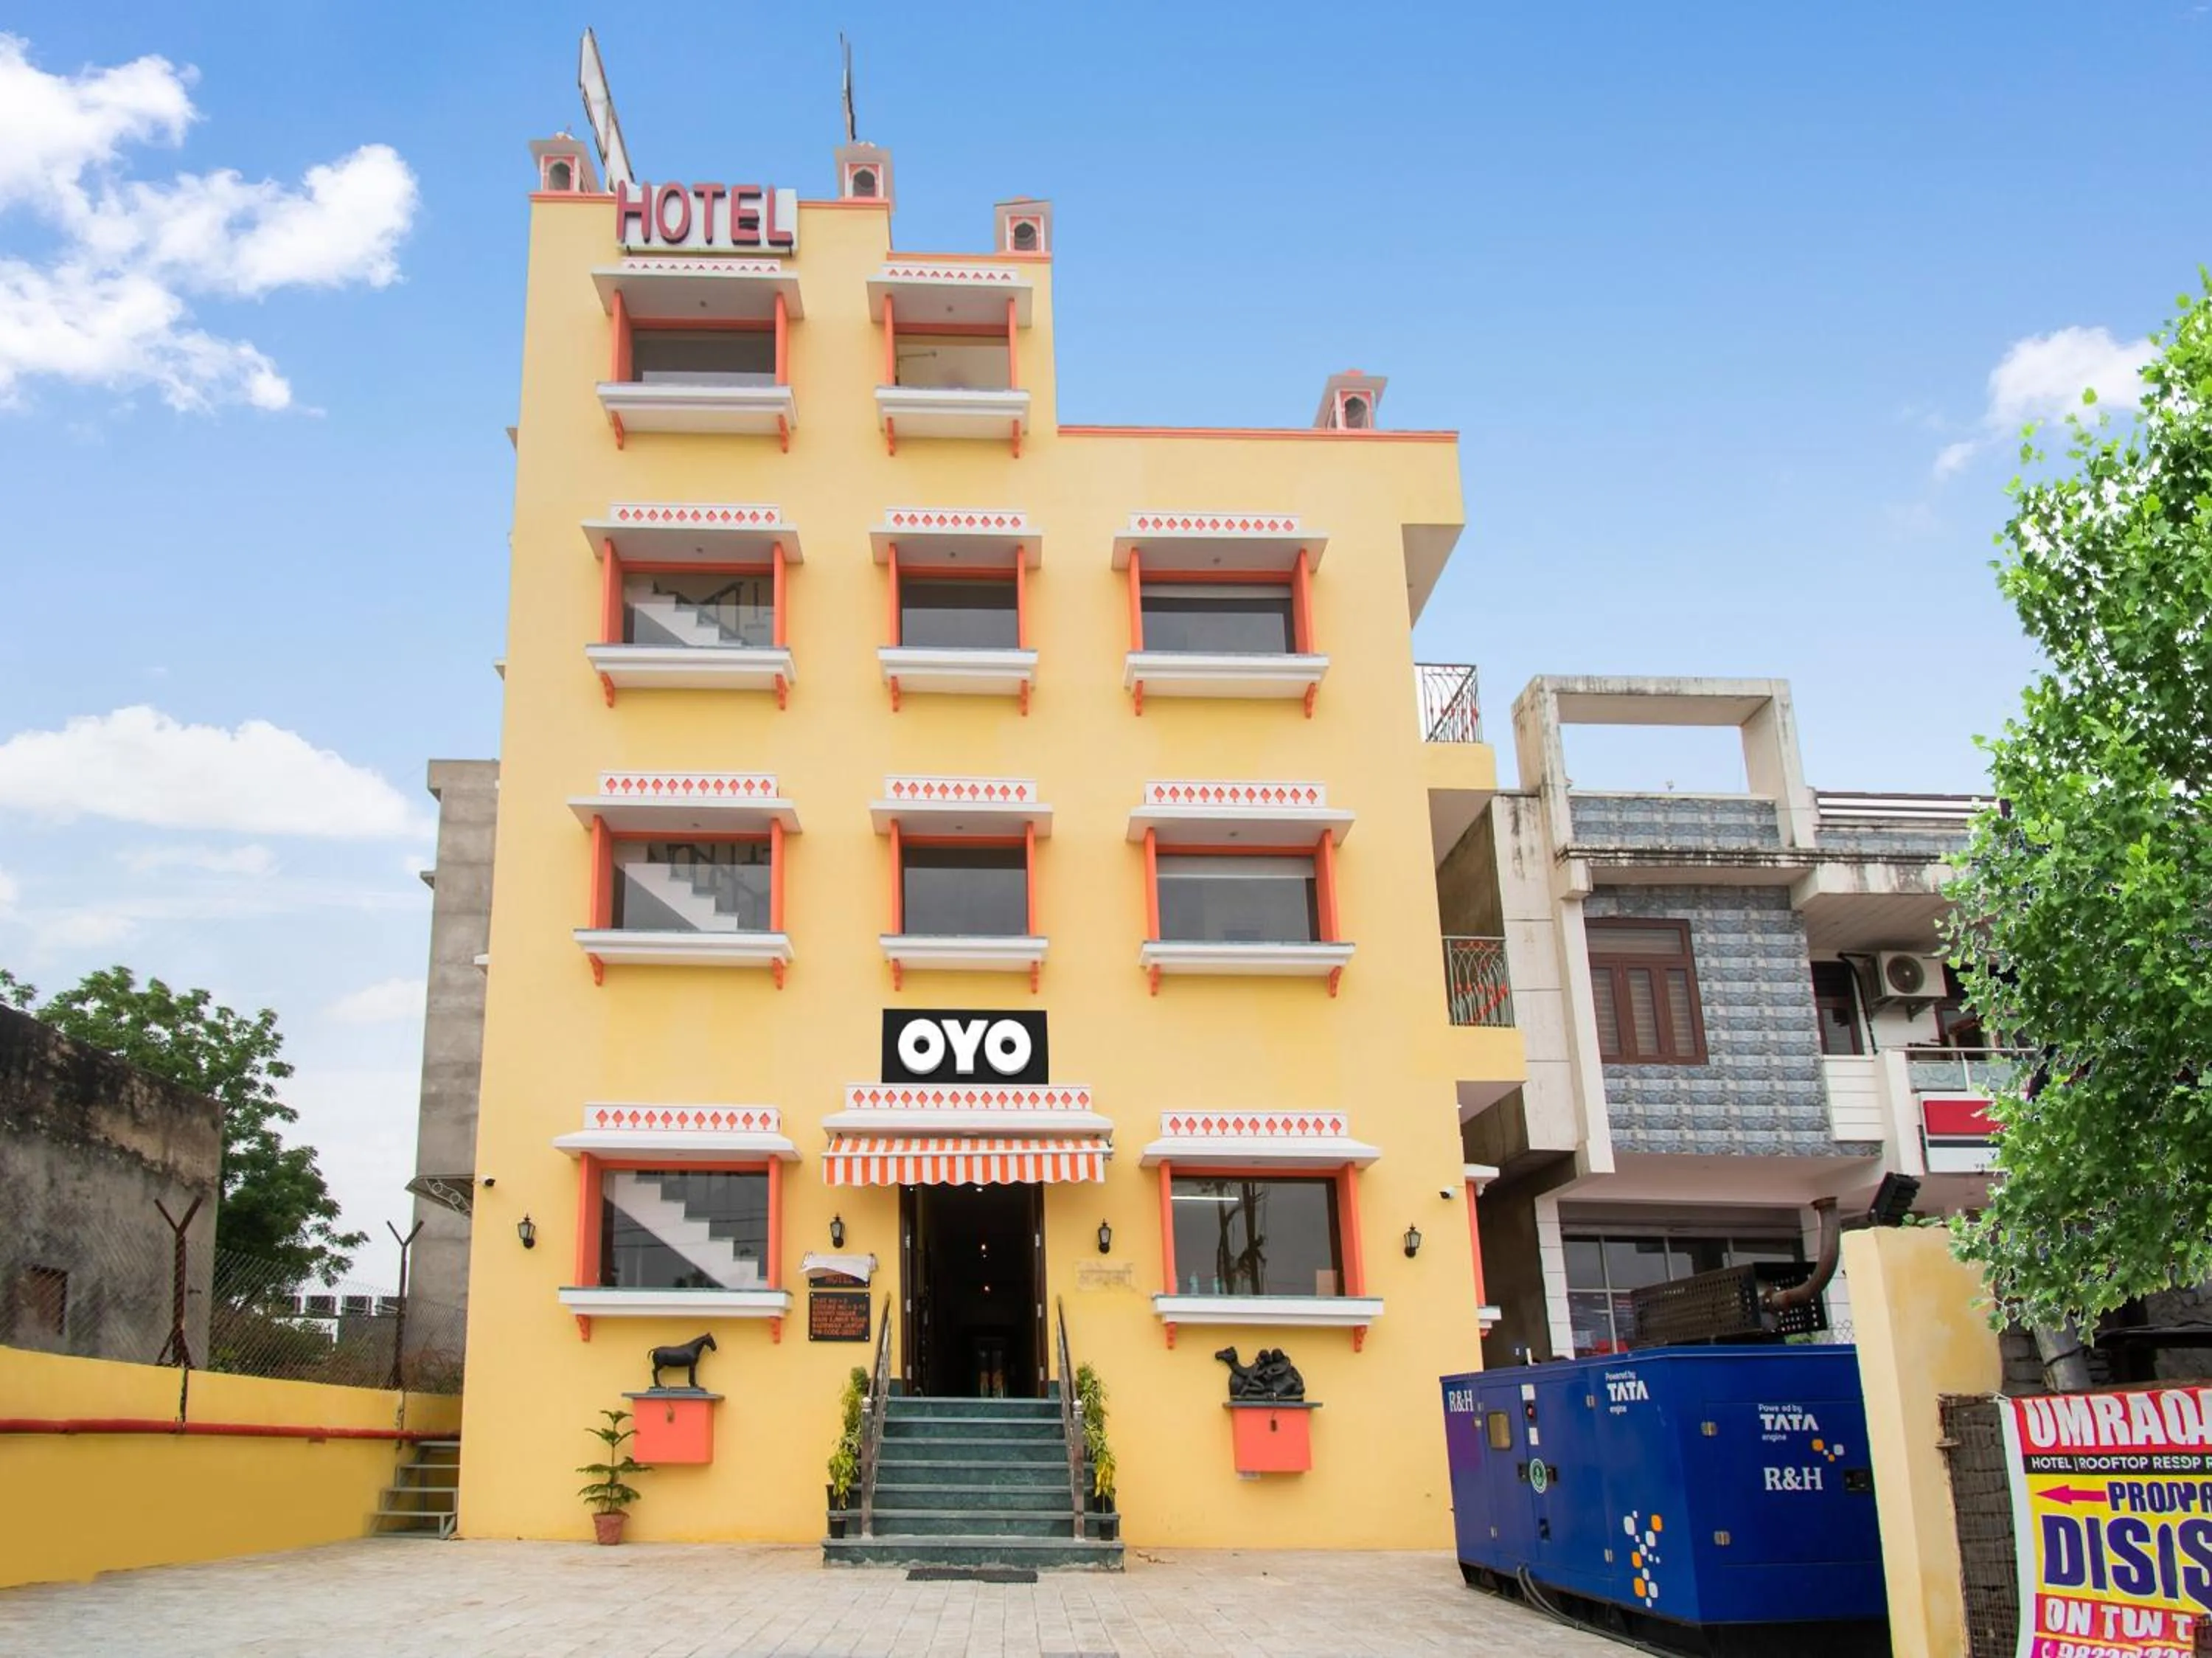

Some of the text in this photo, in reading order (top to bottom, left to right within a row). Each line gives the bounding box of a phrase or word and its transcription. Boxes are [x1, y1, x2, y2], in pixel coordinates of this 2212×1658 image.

[616, 179, 793, 246] HOTEL
[897, 1018, 1032, 1076] OYO
[1448, 1390, 1474, 1412] R&H
[1607, 1380, 1649, 1401] TATA
[1759, 1414, 1820, 1431] TATA
[1761, 1433, 1787, 1443] engine
[2031, 1457, 2073, 1470] HOTEL
[1764, 1466, 1823, 1491] R&H
[2045, 1598, 2091, 1637] ON
